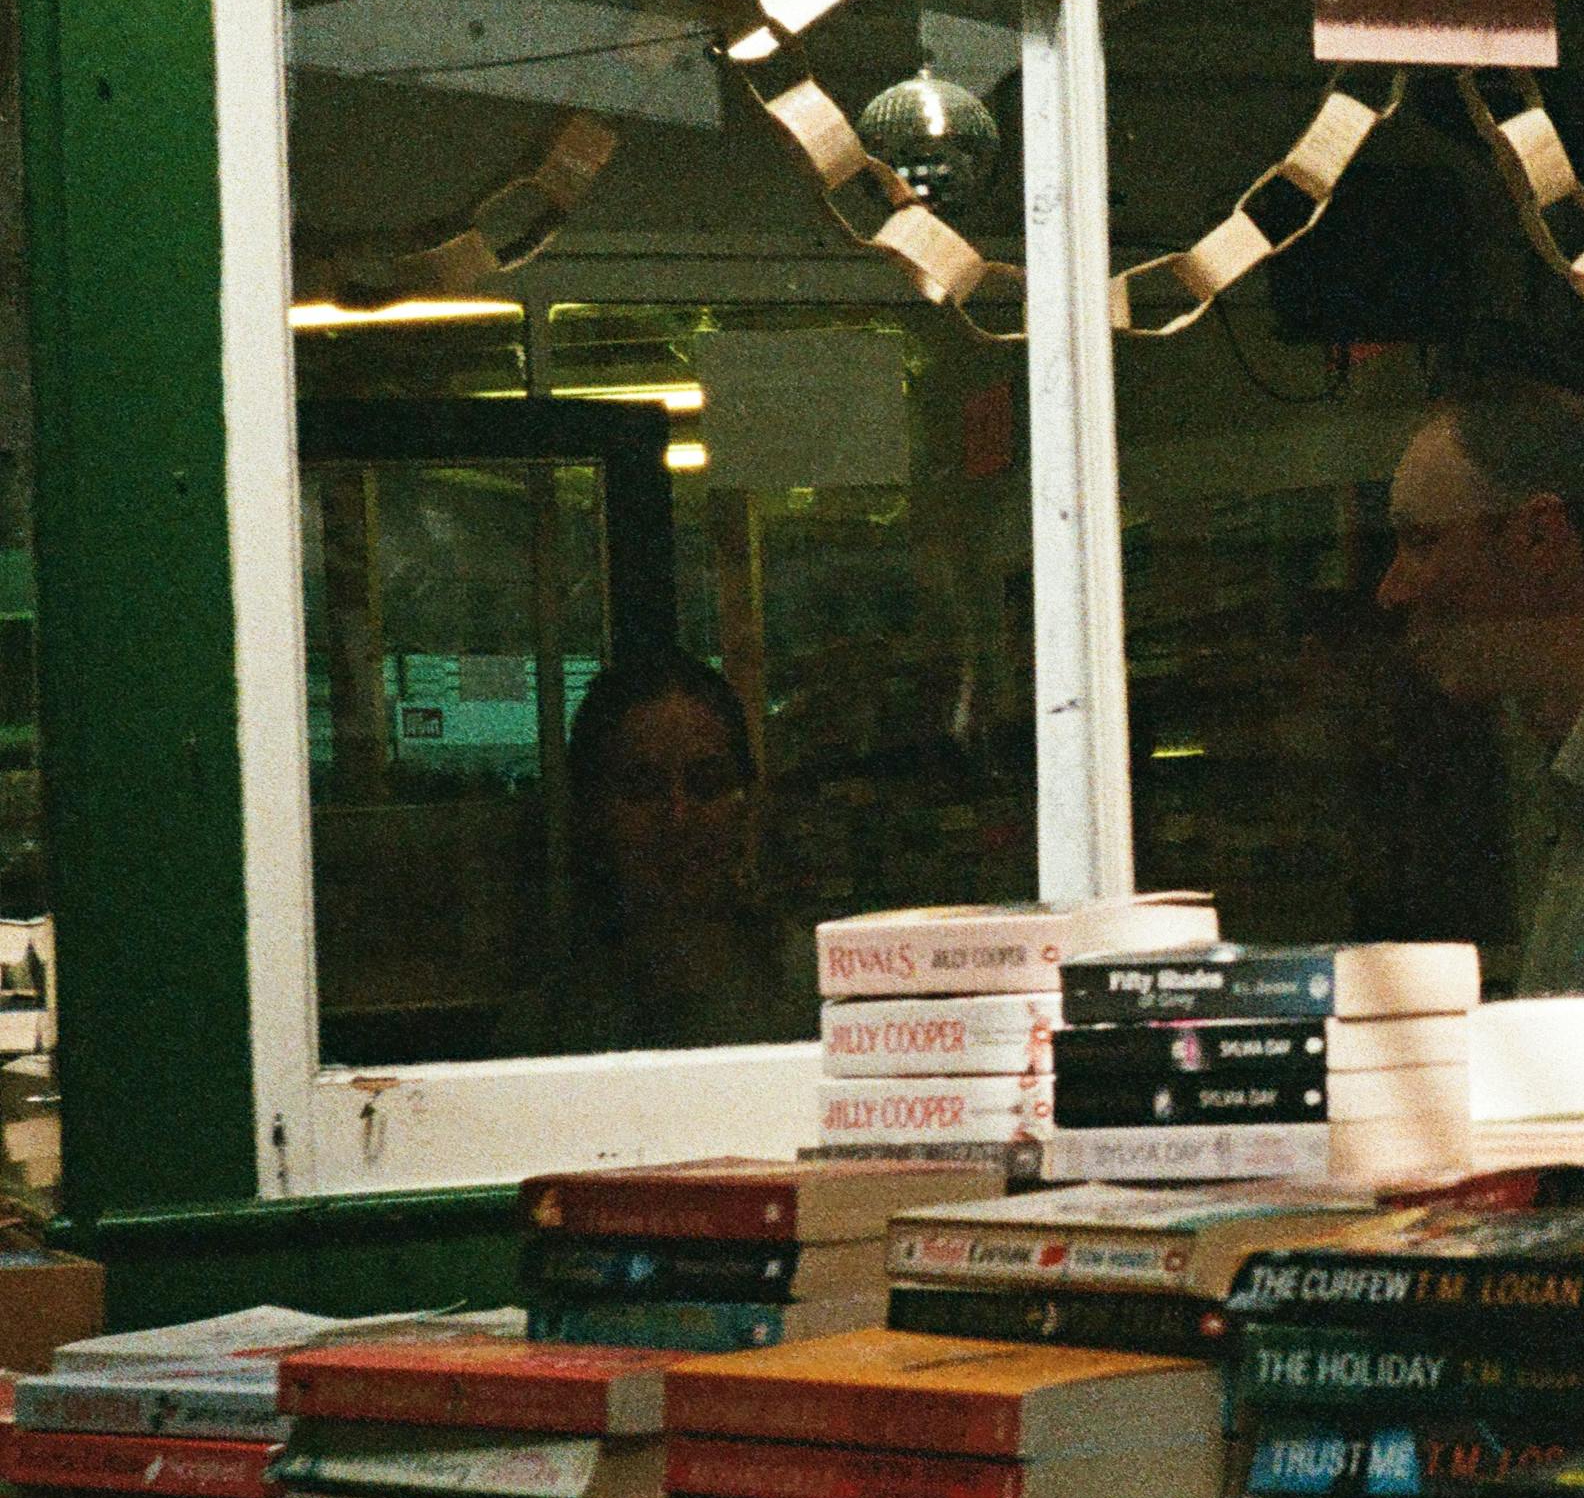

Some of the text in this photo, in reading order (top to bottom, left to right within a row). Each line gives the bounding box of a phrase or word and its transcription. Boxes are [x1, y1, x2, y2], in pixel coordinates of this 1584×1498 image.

[827, 943, 916, 980] RIVALS
[1108, 970, 1154, 995] Fifty
[827, 1020, 967, 1056] JILLY COOPER
[1264, 1038, 1292, 1056] DAY
[823, 1095, 966, 1131] JILLY COOPER
[1247, 1089, 1279, 1107] DAY
[1250, 1267, 1583, 1307] THE CURFEW LOGAN
[1257, 1350, 1311, 1383] THE
[1316, 1350, 1446, 1389] HOLIDAY
[1271, 1438, 1414, 1478] TRUST ME
